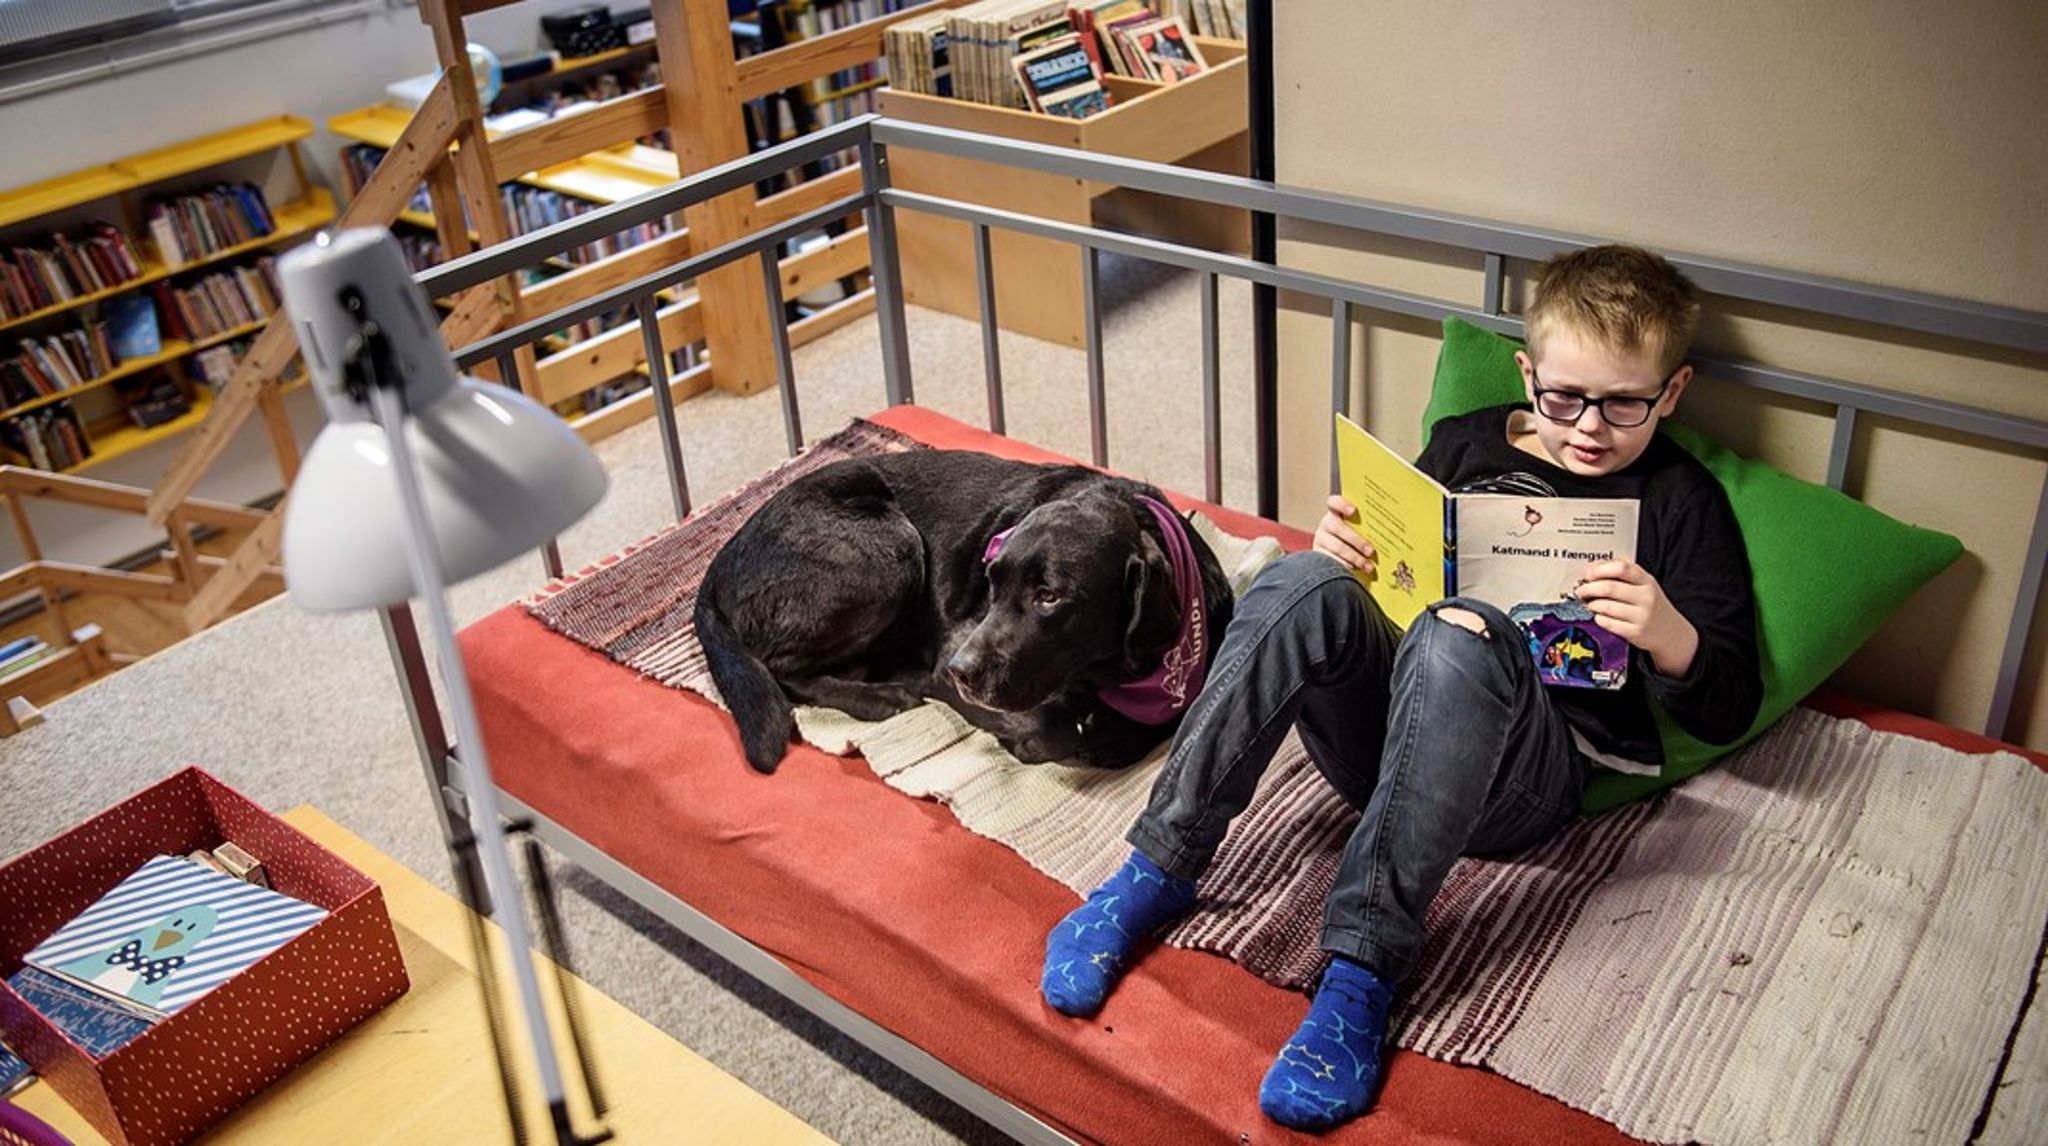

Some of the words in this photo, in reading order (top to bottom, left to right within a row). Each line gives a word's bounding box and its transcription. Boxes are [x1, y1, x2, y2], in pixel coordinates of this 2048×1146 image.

[1491, 544, 1550, 558] Katmand
[1553, 548, 1558, 558] i
[1561, 549, 1614, 562] fængsel
